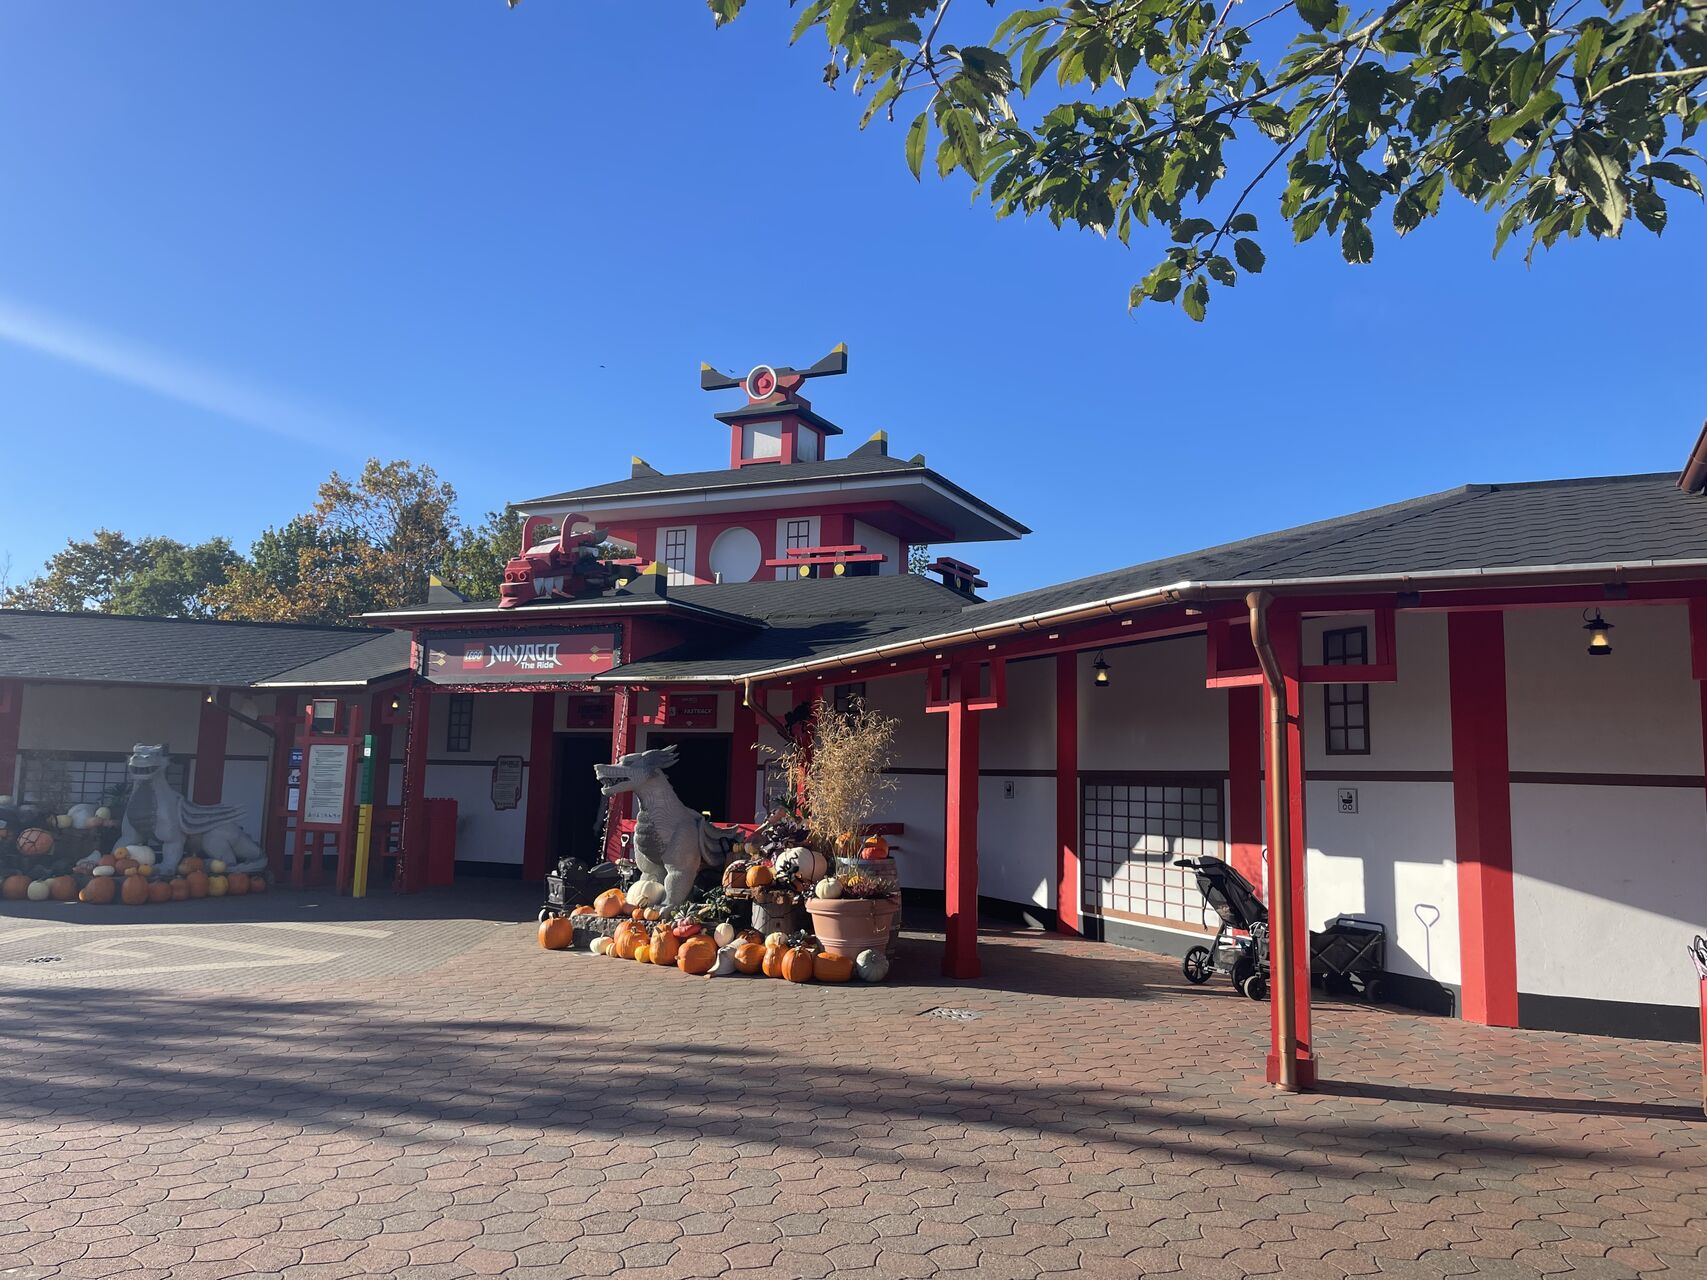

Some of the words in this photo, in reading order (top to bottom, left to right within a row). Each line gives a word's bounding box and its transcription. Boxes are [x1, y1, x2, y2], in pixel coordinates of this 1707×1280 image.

[464, 650, 483, 661] LEGO
[485, 643, 562, 668] NINJAGO
[521, 661, 535, 669] The
[536, 661, 555, 669] Ride
